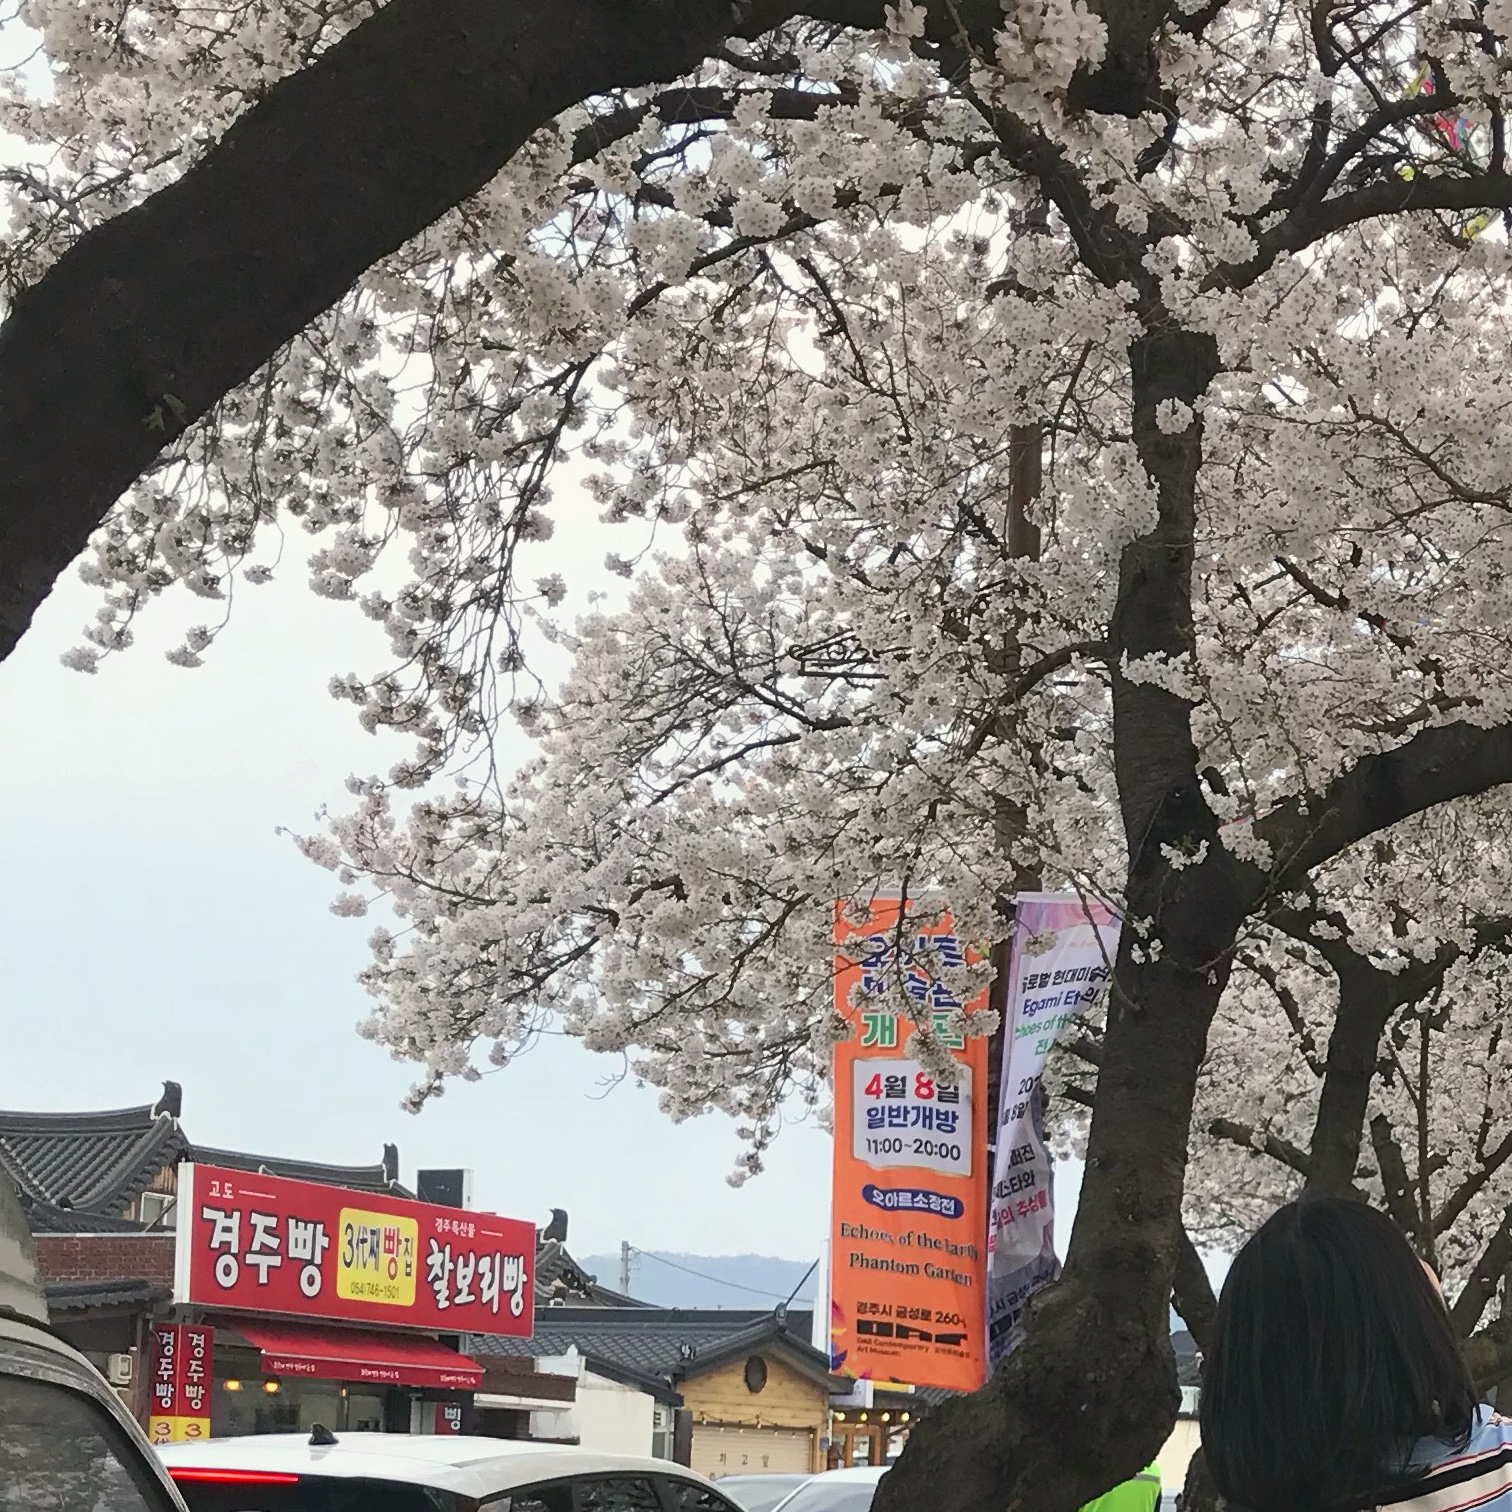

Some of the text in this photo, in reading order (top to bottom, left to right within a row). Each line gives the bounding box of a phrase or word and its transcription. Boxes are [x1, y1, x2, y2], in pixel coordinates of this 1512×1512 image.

[1023, 991, 1062, 1017] Egami
[864, 1071, 960, 1104] 4월 8일
[866, 1105, 960, 1134] 일반개방
[866, 1137, 961, 1161] 11:00~20:00
[209, 1180, 235, 1199] 고도
[872, 1189, 955, 1215] 오아르소장전
[435, 1217, 476, 1239] 경주특산물
[840, 1222, 894, 1244] Echoes
[898, 1231, 915, 1246] of
[917, 1232, 943, 1250] the
[202, 1205, 330, 1298] 경주빵
[849, 1252, 920, 1275] Phantom
[426, 1238, 528, 1317] 찰보리빵
[856, 1301, 893, 1318] 경주시
[155, 1331, 175, 1409] 경주빵
[185, 1333, 206, 1410] 경주빵
